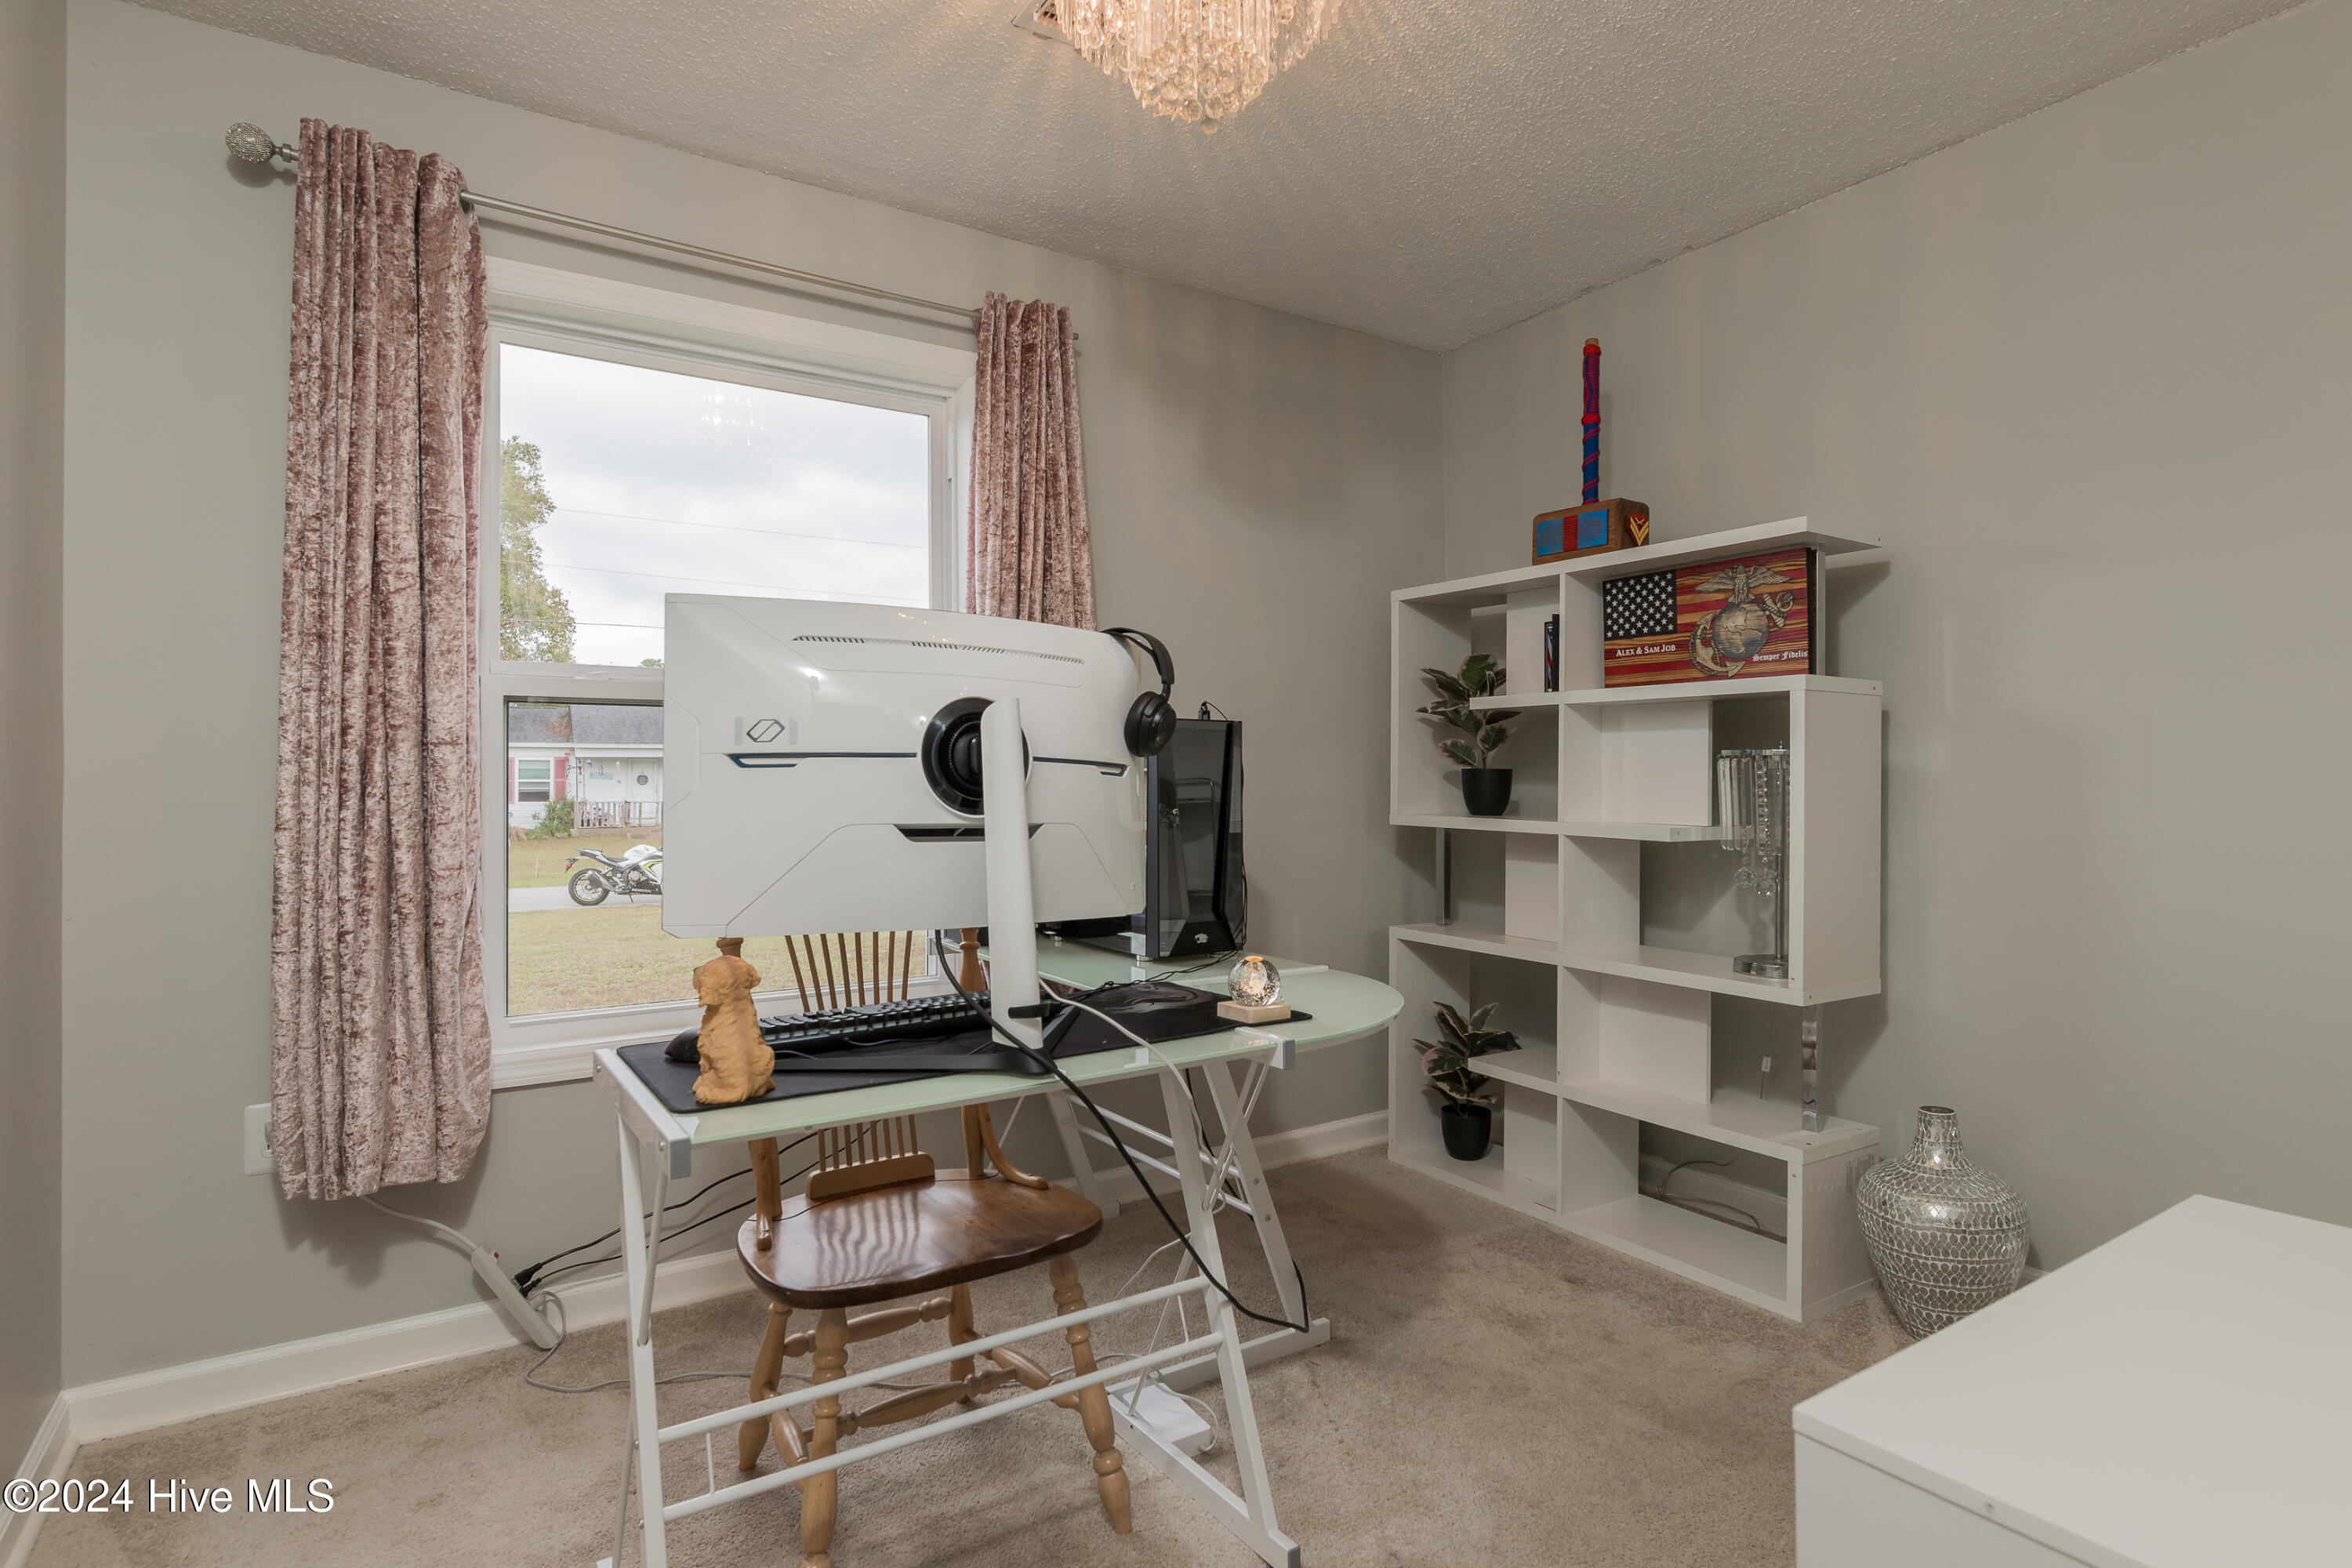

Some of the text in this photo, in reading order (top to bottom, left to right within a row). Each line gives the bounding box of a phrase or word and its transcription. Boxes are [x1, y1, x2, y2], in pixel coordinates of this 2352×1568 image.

[1644, 645, 1661, 654] SAM
[1752, 650, 1809, 662] Semper Fidelis
